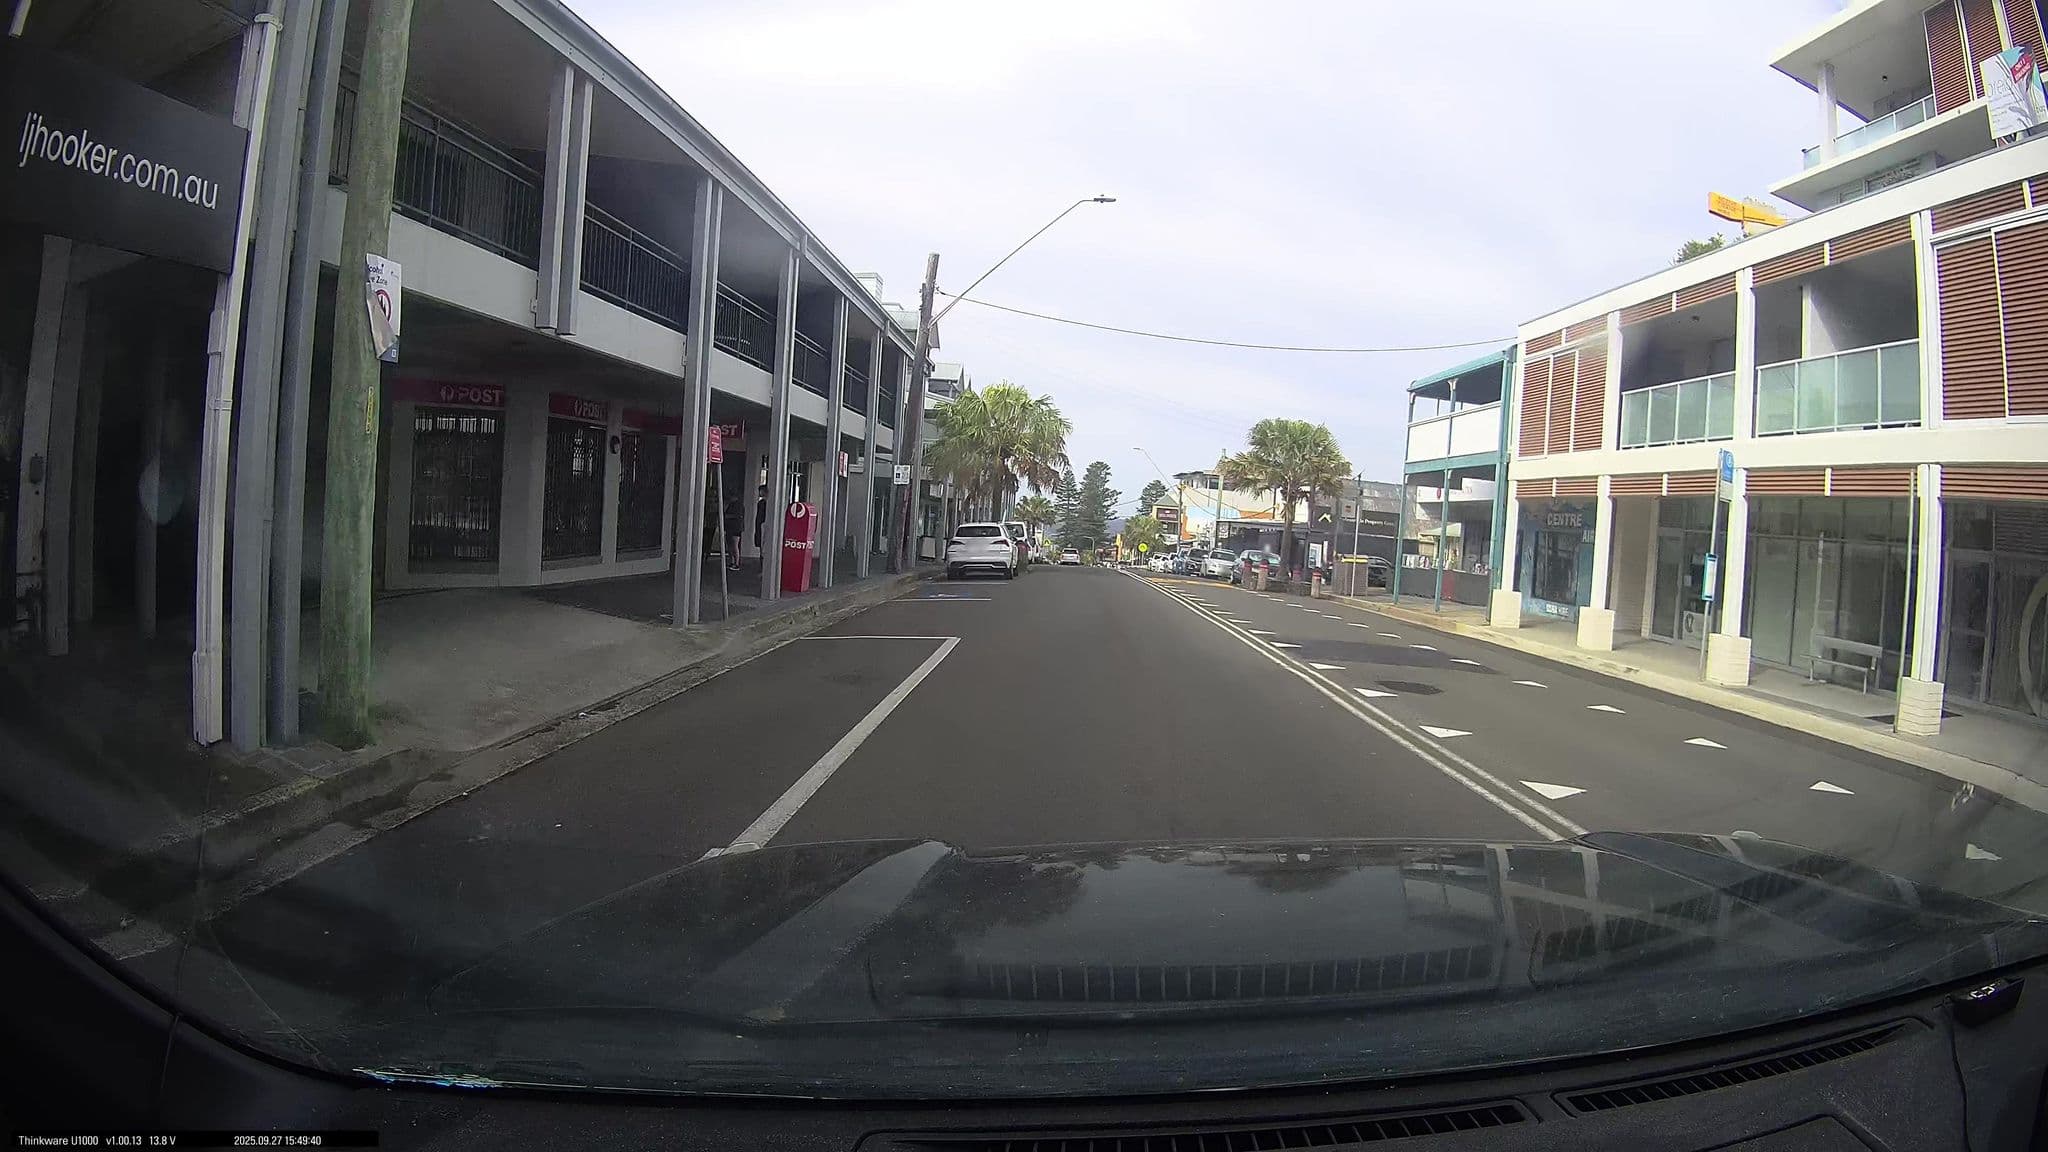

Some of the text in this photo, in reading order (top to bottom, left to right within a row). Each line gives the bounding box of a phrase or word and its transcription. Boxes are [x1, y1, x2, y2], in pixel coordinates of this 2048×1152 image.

[18, 111, 219, 210] ljhooker.com.au
[457, 386, 504, 403] POST
[1547, 512, 1582, 527] CENTRE
[784, 540, 806, 550] POST
